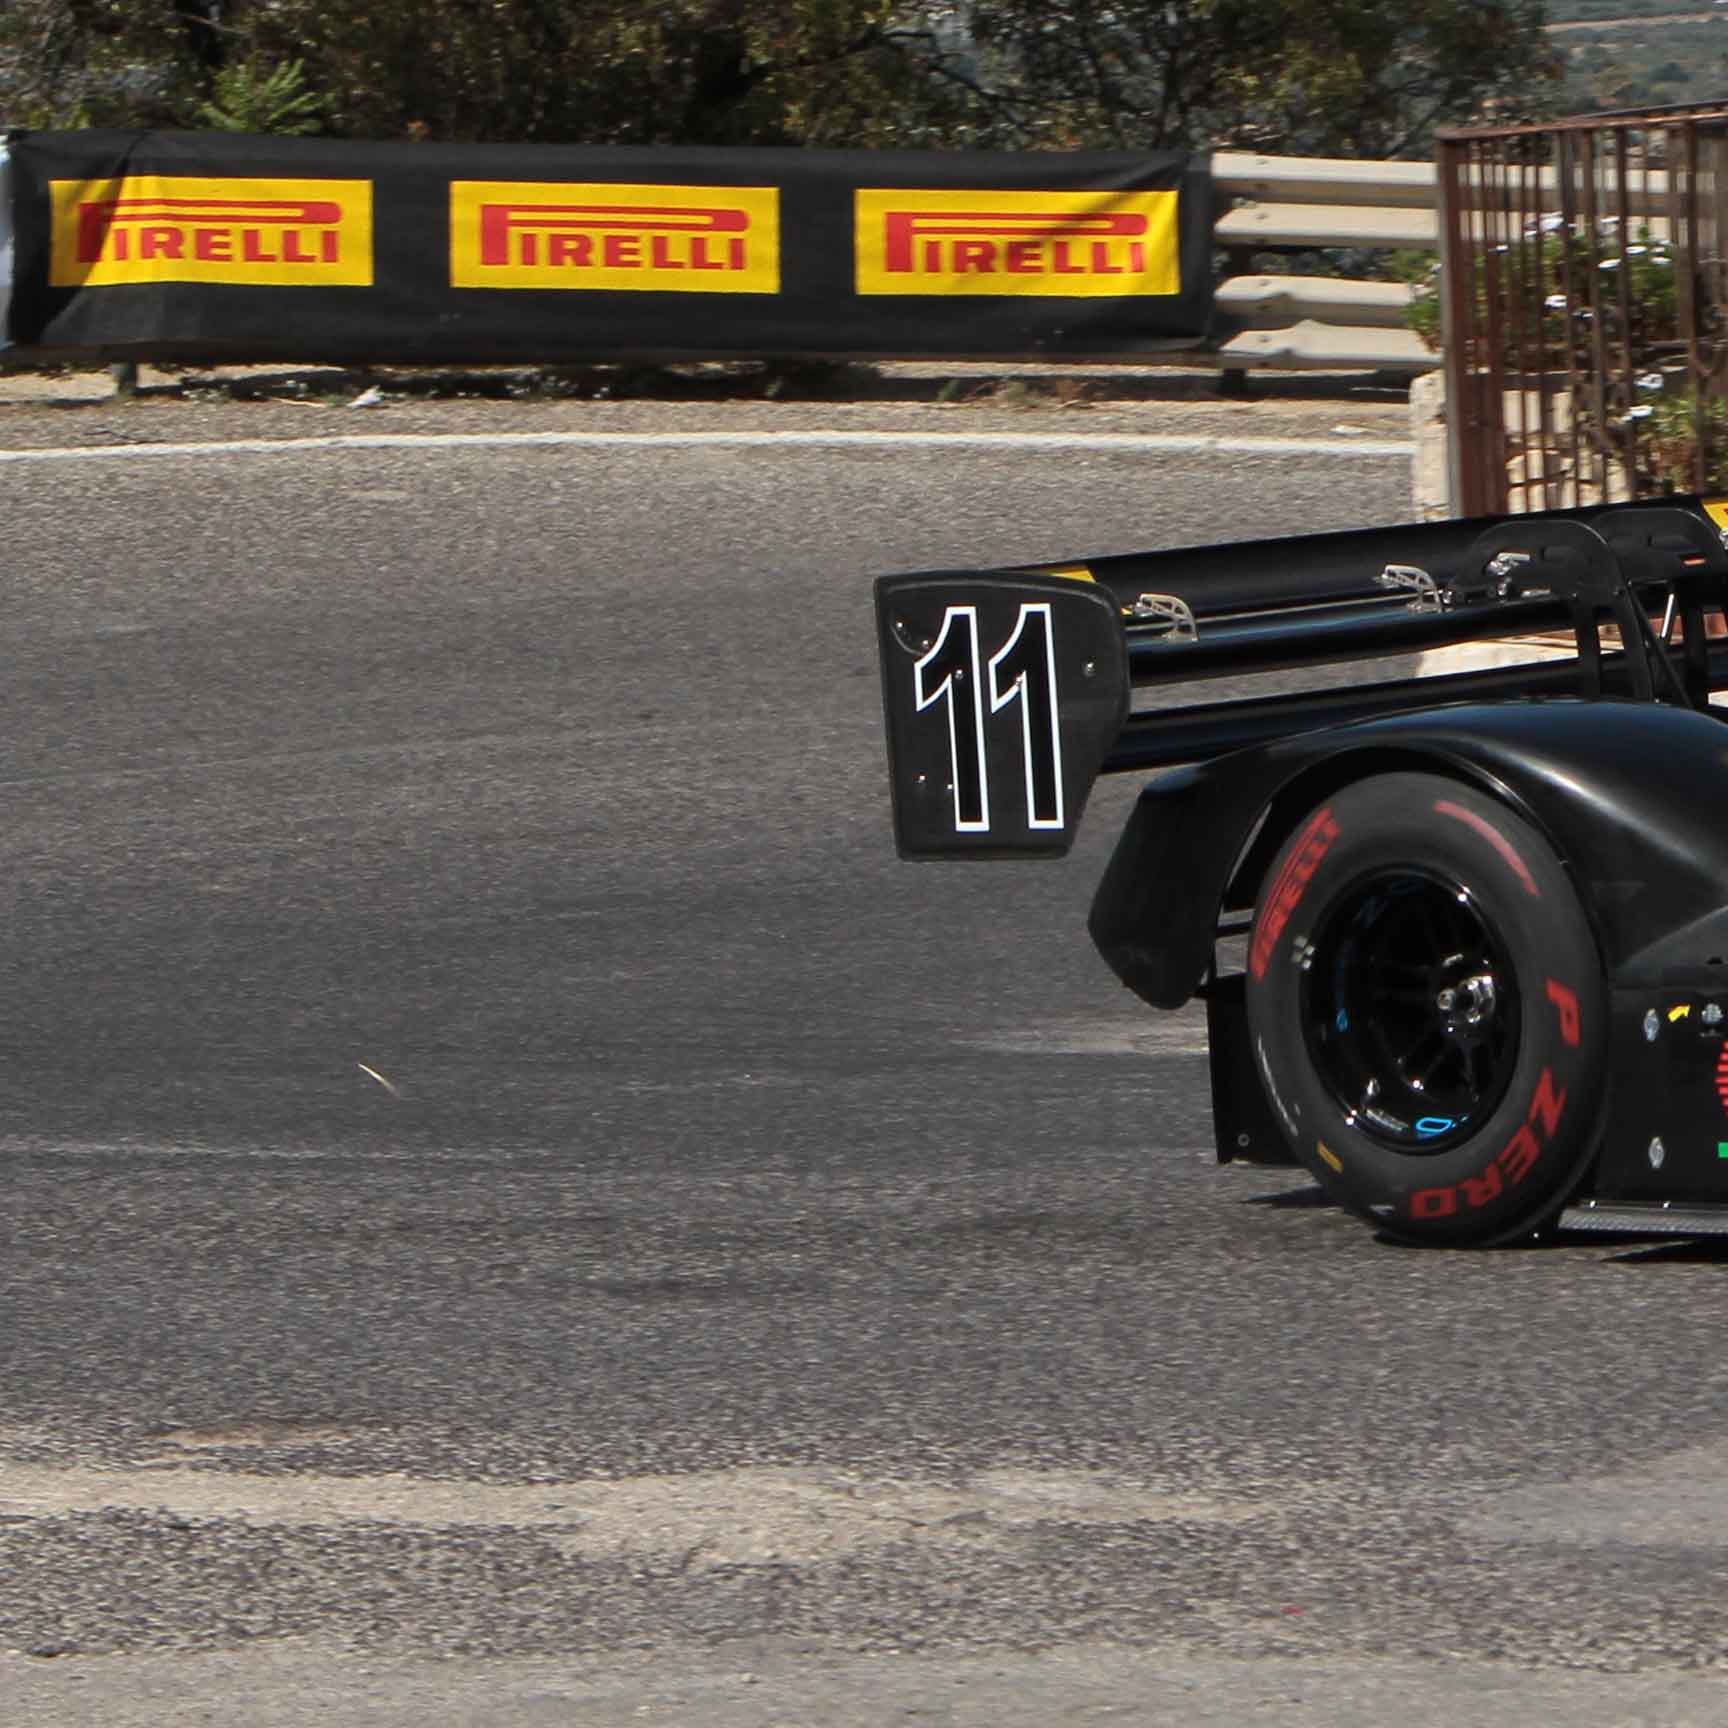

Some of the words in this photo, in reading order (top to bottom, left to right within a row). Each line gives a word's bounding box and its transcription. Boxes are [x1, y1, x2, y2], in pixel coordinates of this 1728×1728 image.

[78, 199, 340, 264] PIRELLI
[480, 204, 750, 271] PIRELLI
[885, 211, 1148, 275] PIRELLI
[914, 603, 1064, 832] 11
